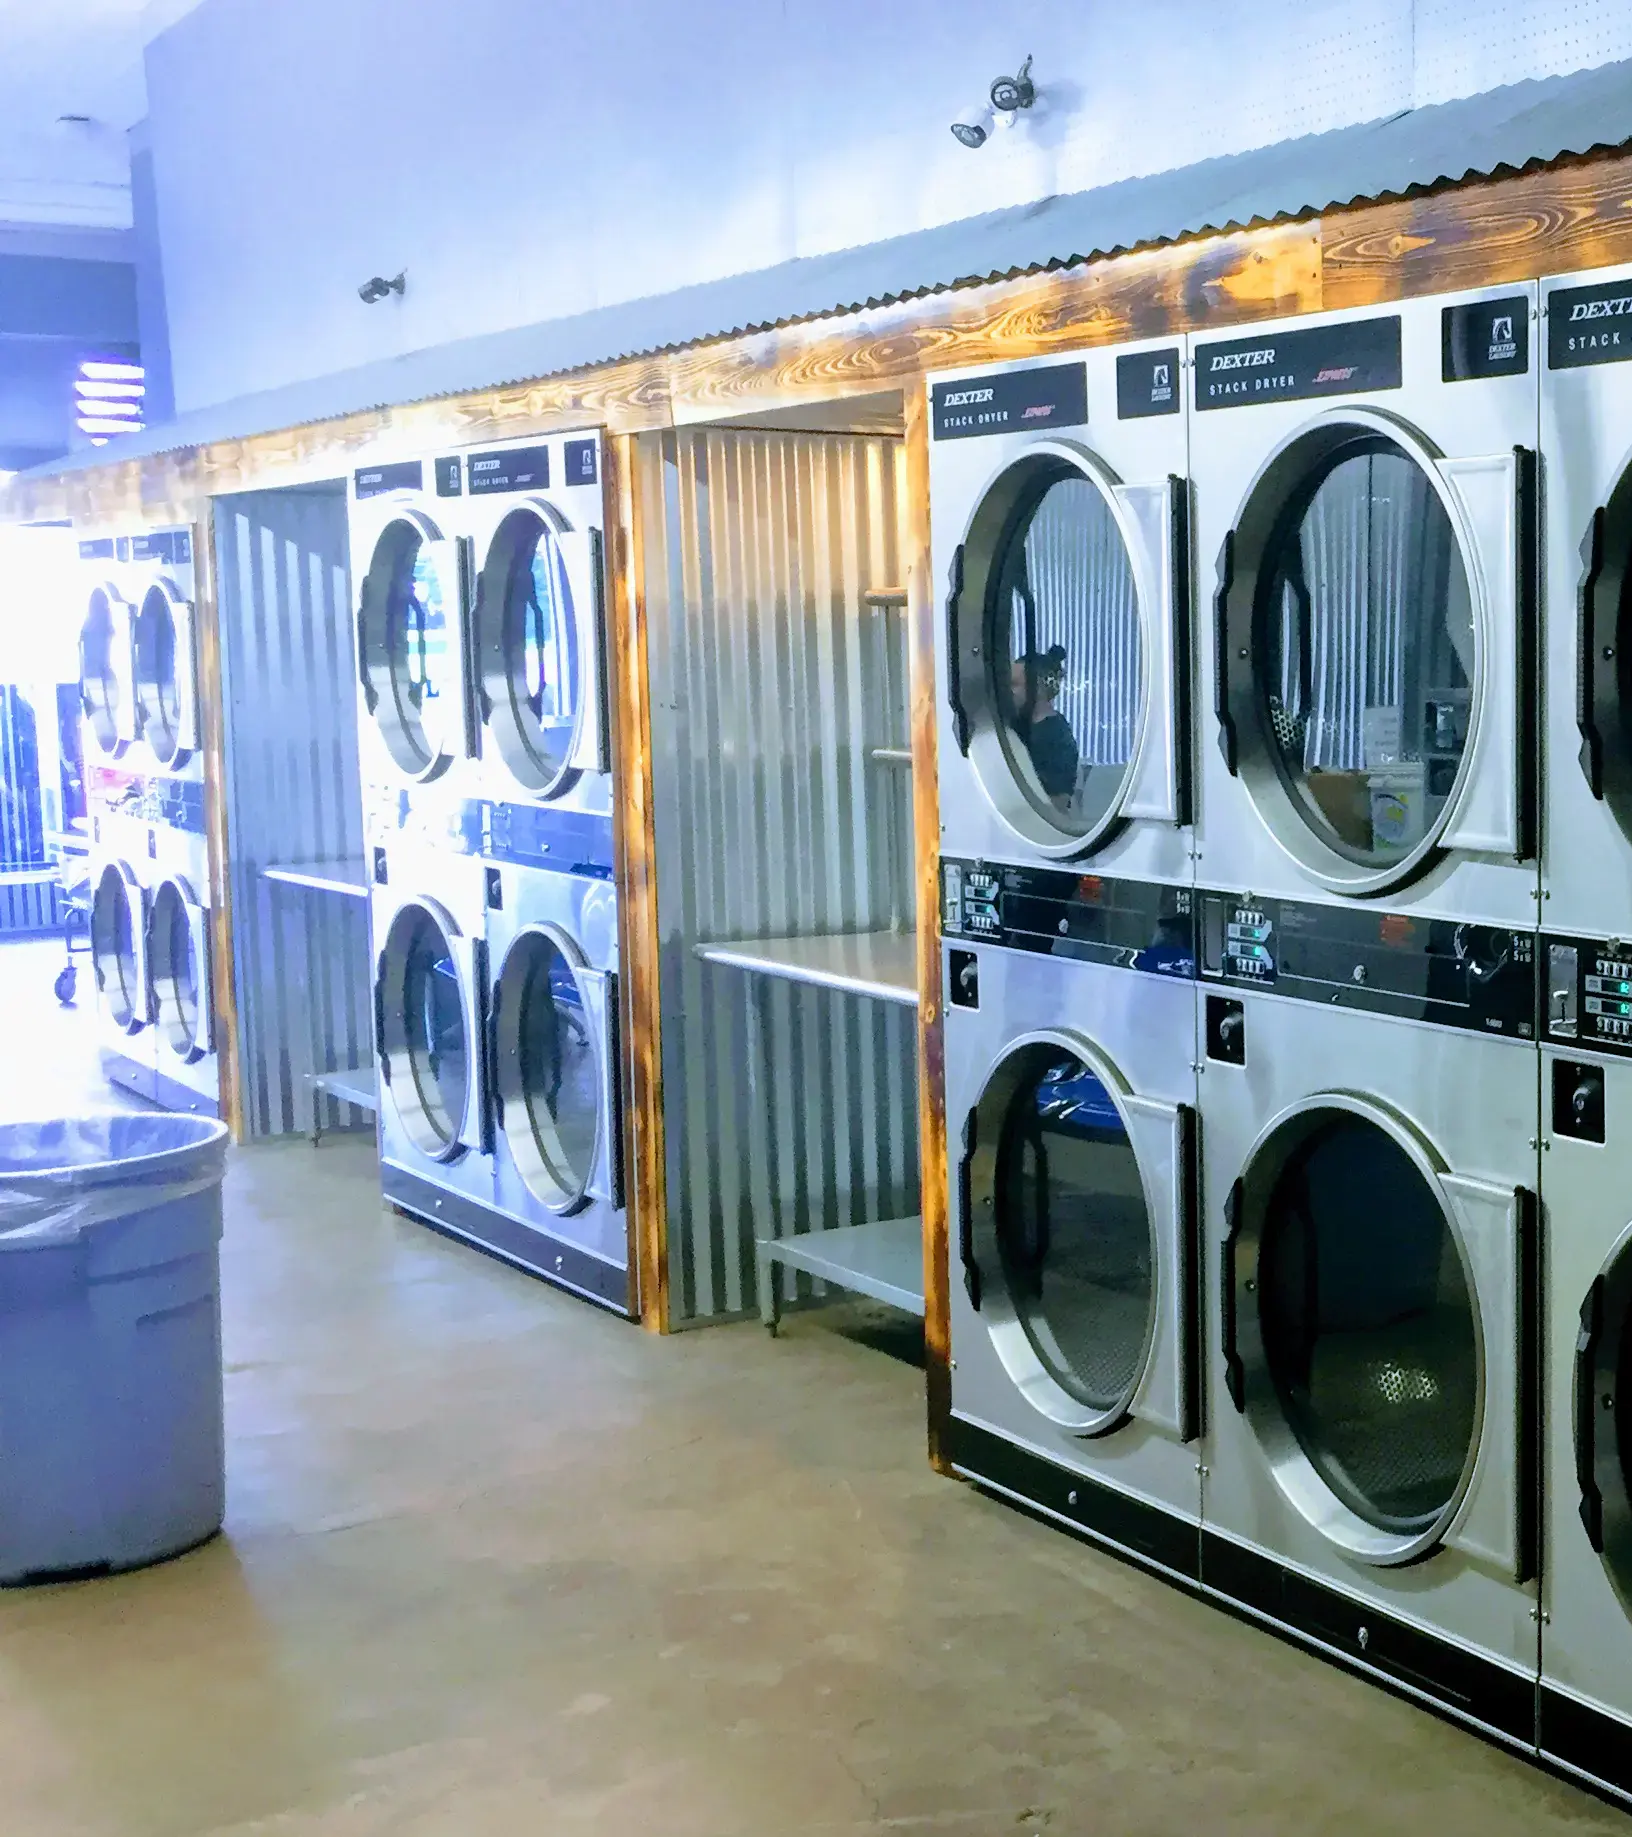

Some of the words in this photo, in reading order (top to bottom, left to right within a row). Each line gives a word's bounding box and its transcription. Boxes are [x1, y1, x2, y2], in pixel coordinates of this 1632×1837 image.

[1568, 332, 1620, 350] STACK
[1210, 349, 1275, 371] DEXTER
[1209, 381, 1247, 395] STACK
[1255, 375, 1295, 390] DRYER
[944, 388, 994, 407] DEXTER
[944, 416, 973, 428] STACK
[979, 411, 1008, 424] DRYER
